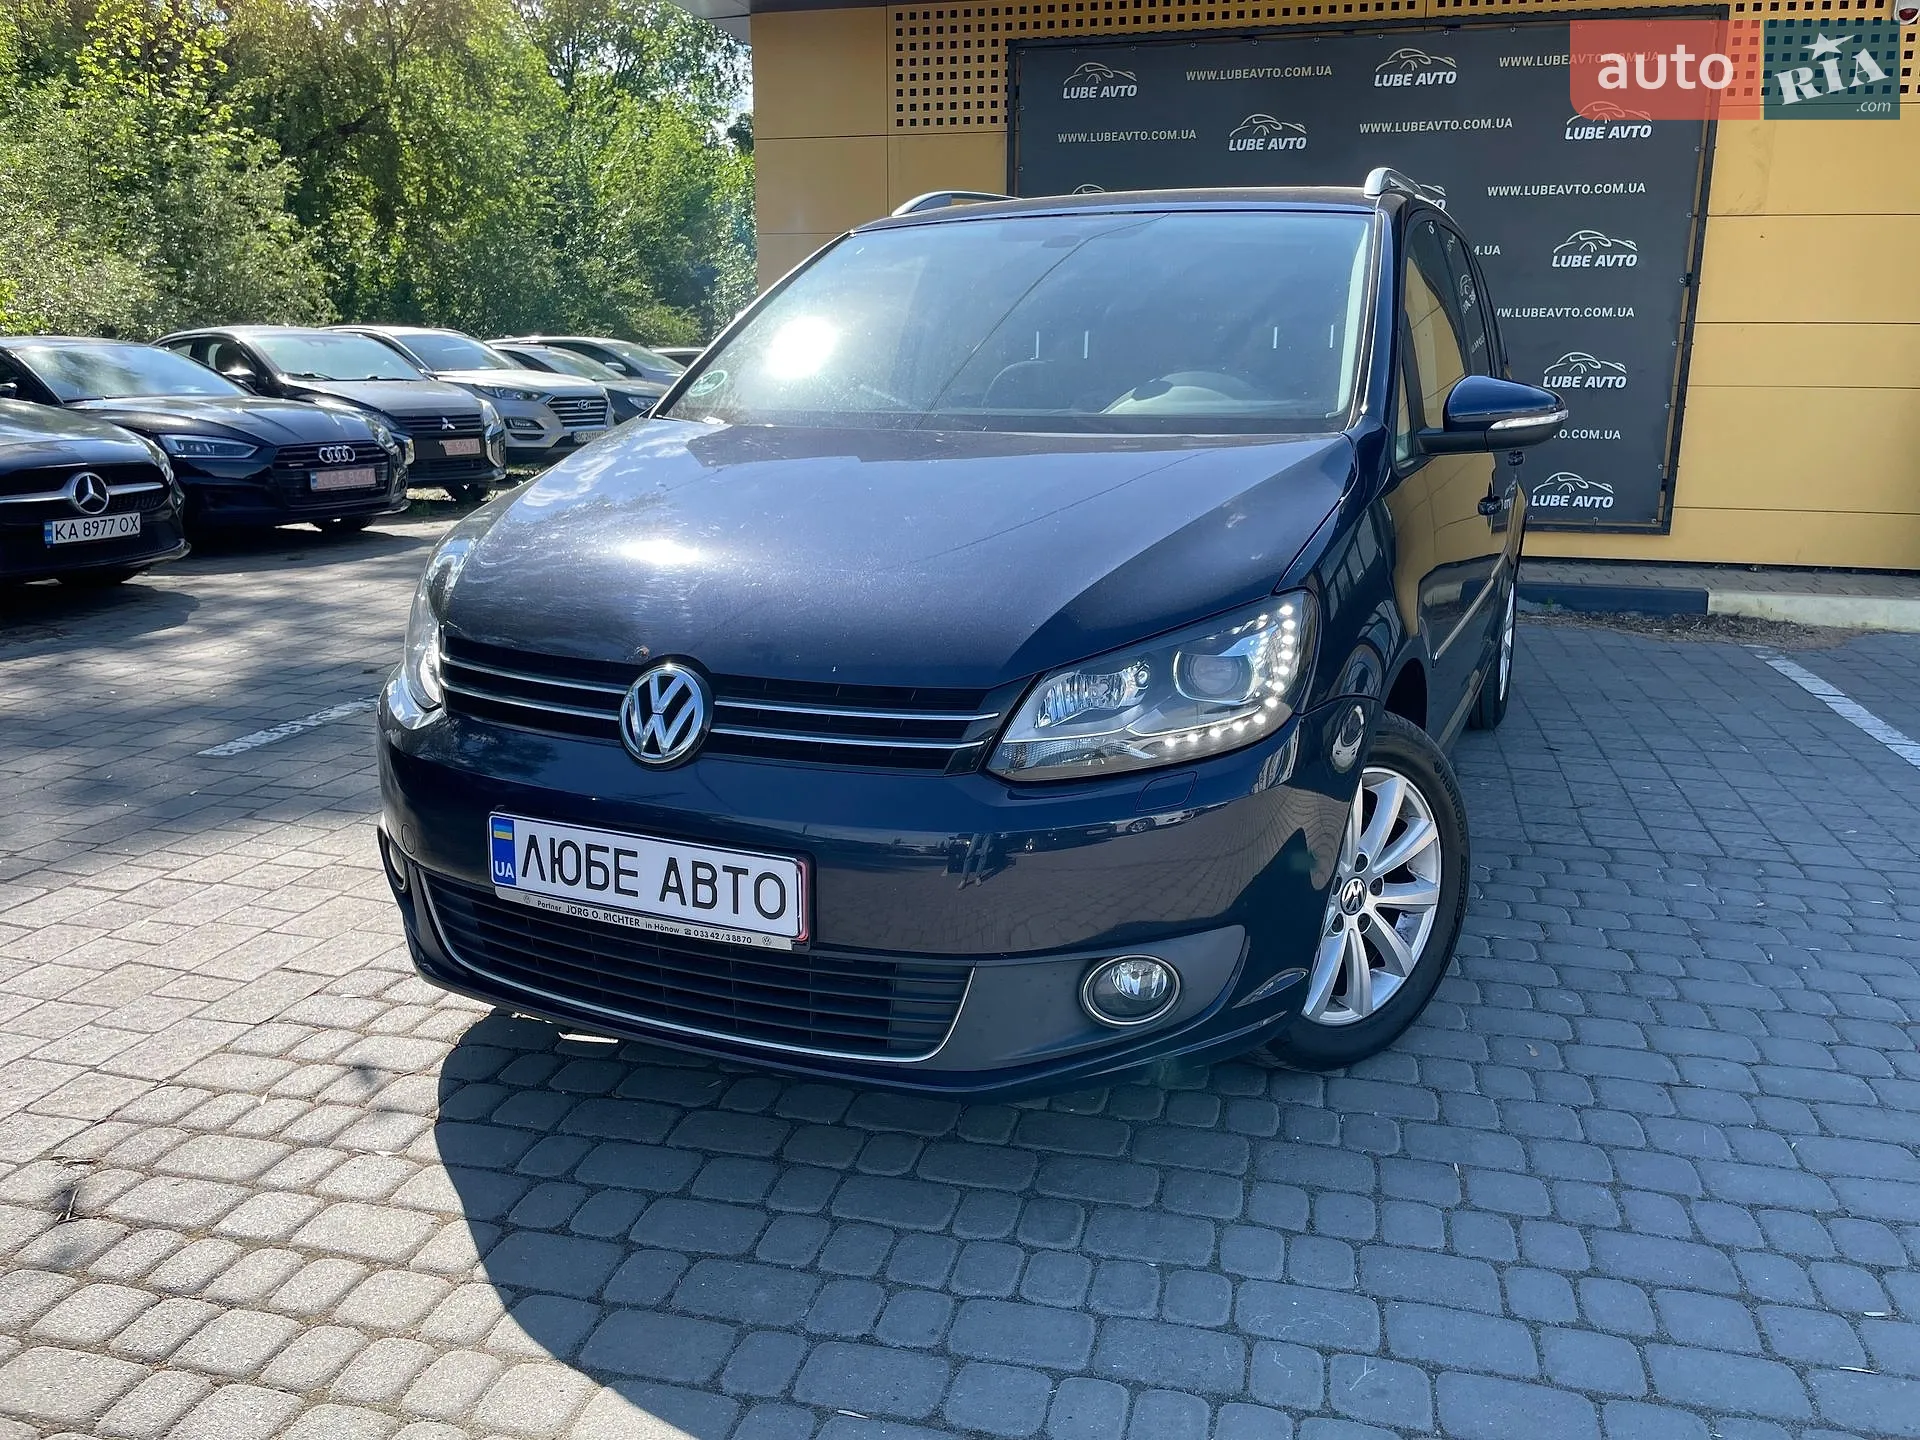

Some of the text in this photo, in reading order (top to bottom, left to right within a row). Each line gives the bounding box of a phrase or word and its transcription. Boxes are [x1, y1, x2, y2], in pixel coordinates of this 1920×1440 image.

[1186, 65, 1332, 81] WWW.LUBEAVTO.COM.UA
[1375, 71, 1457, 87] LUBE AVTO
[1062, 84, 1138, 99] LUBE AVTO
[1359, 117, 1513, 134] WWW.LUBEAVTO.COM.UA
[1564, 125, 1653, 140] LUBE AVTO
[1057, 128, 1197, 143] WWW.LUBEAVTO.COM.UA
[1228, 136, 1307, 151] LUBE AVTO
[1487, 182, 1646, 197] WWW.LUBEAVTO.COM.UA
[1552, 253, 1639, 268] LUBE AVTO
[1542, 375, 1628, 389] LUBE AVTO
[1531, 494, 1615, 509] LUBE AVTO
[55, 515, 139, 541] KA 8977 OX
[494, 860, 515, 879] UA
[521, 834, 787, 920] ЛЮБЕ АВТО
[537, 900, 562, 912] Partner
[603, 912, 641, 927] RICHTER
